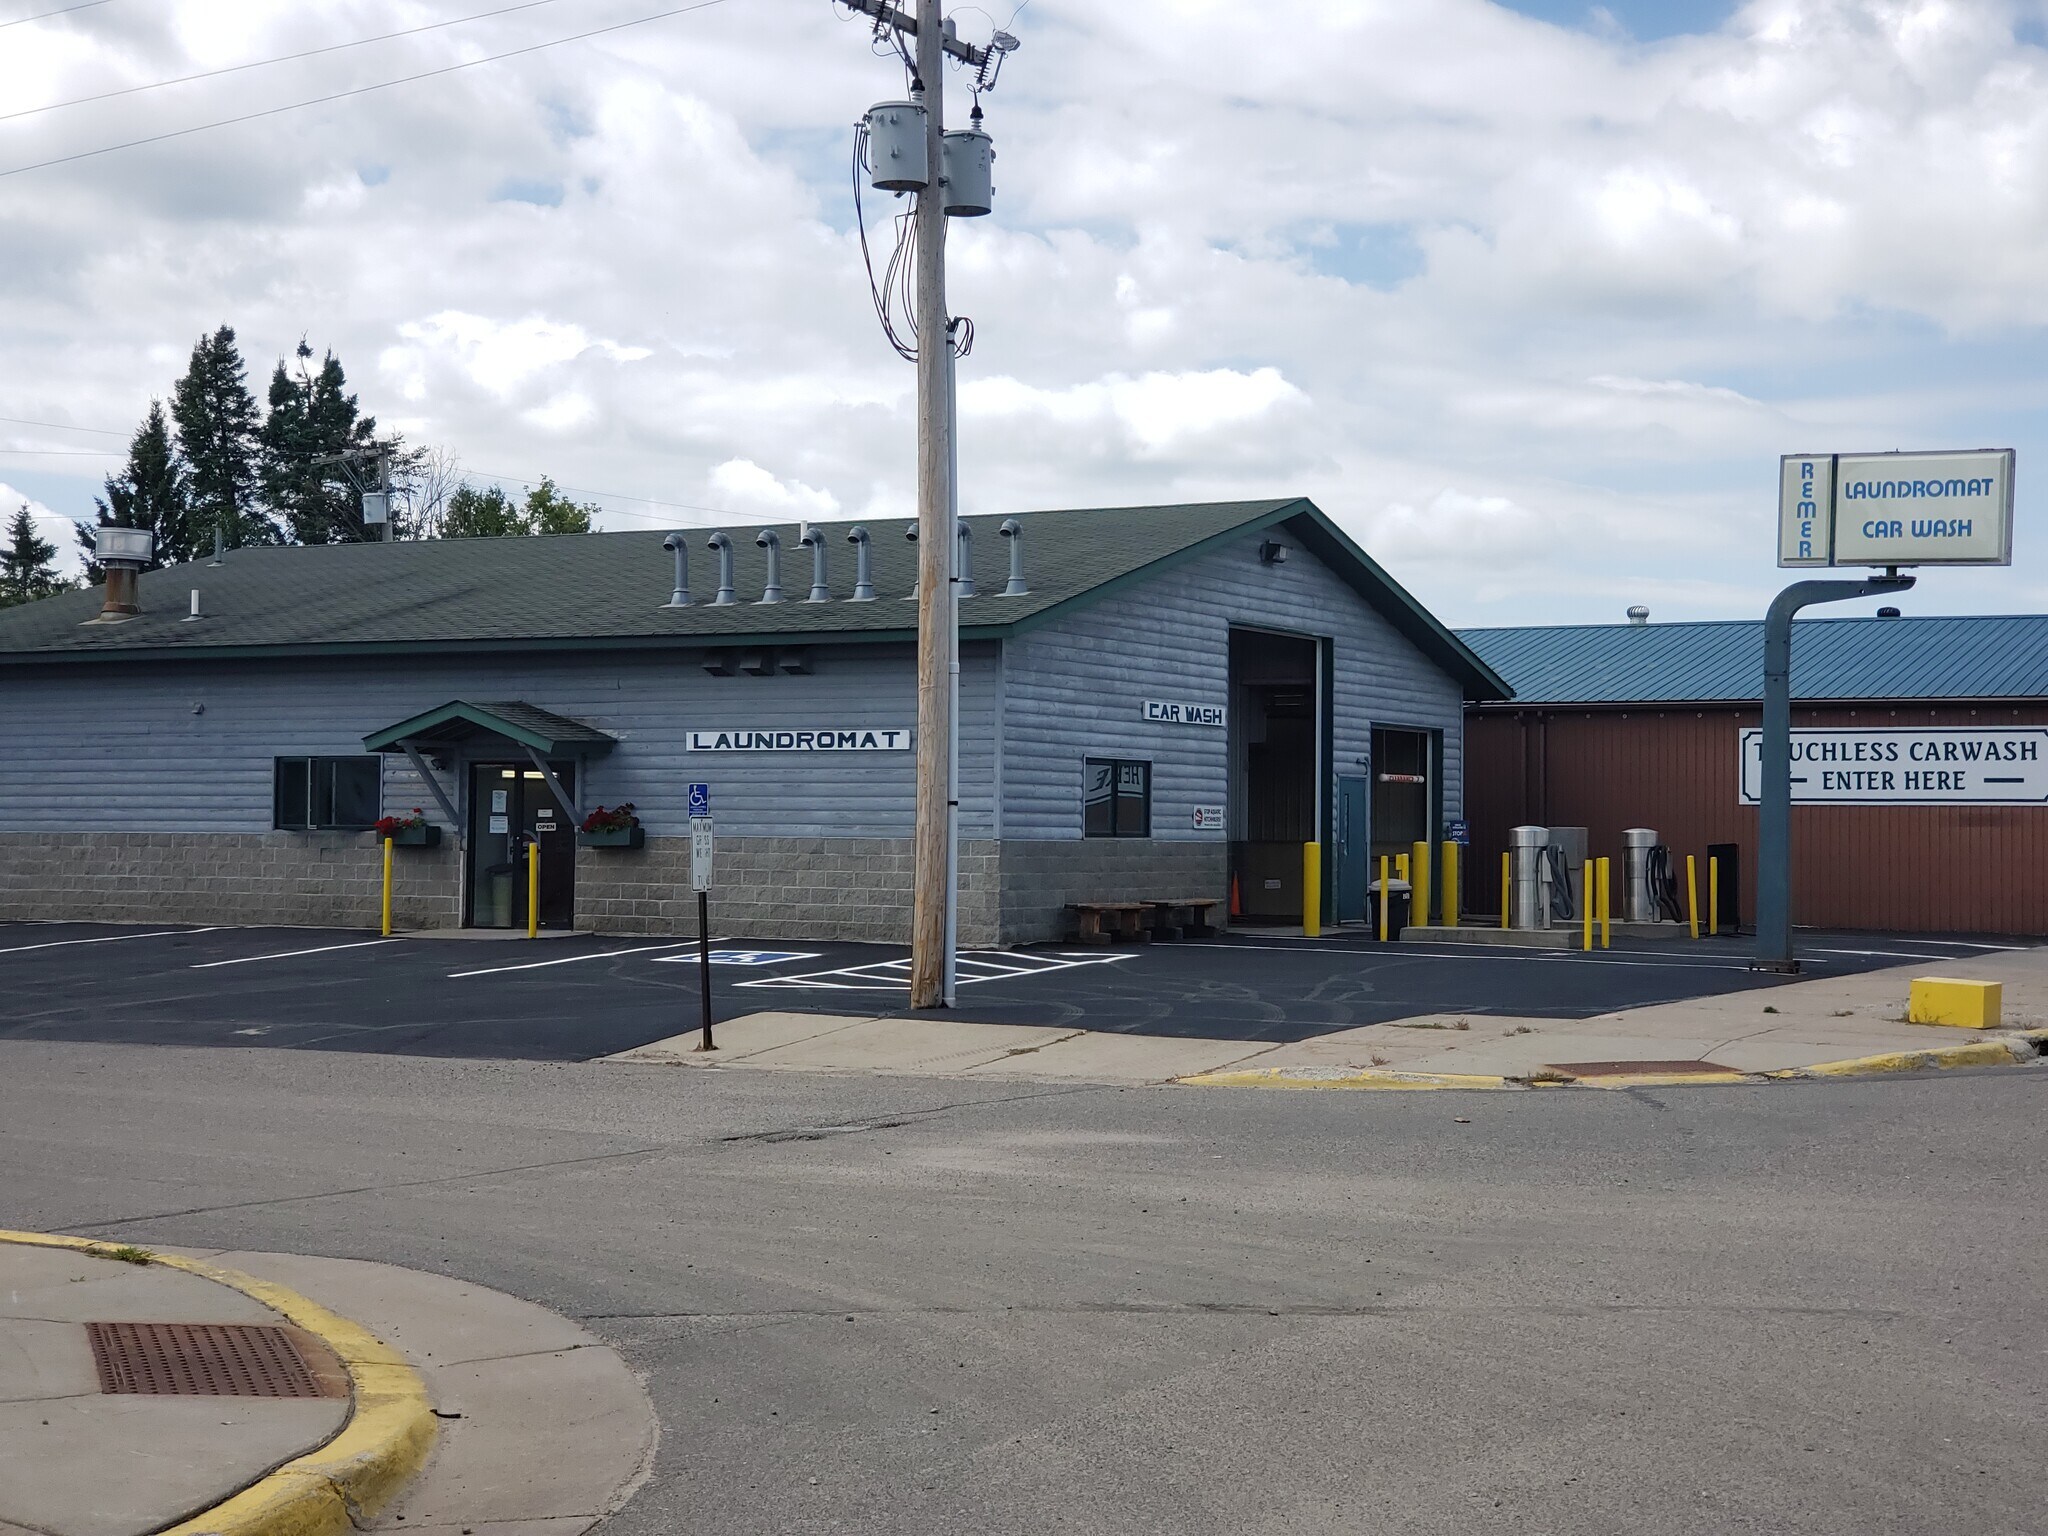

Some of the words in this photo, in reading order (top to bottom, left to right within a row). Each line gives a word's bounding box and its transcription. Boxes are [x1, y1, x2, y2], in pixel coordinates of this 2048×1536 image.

[1845, 478, 1994, 500] LAUNDROMAT
[1796, 462, 1817, 558] REMER
[1862, 520, 1903, 539] CAR
[1911, 519, 1972, 538] WASH
[1149, 703, 1180, 723] CAR
[1185, 706, 1222, 724] WASH
[693, 731, 901, 751] LAUNDROMAT
[1753, 741, 1899, 762] TUCHLESS
[1909, 740, 2038, 761] CARWASH
[1822, 771, 1896, 790] ENTER
[1904, 771, 1966, 790] HERE
